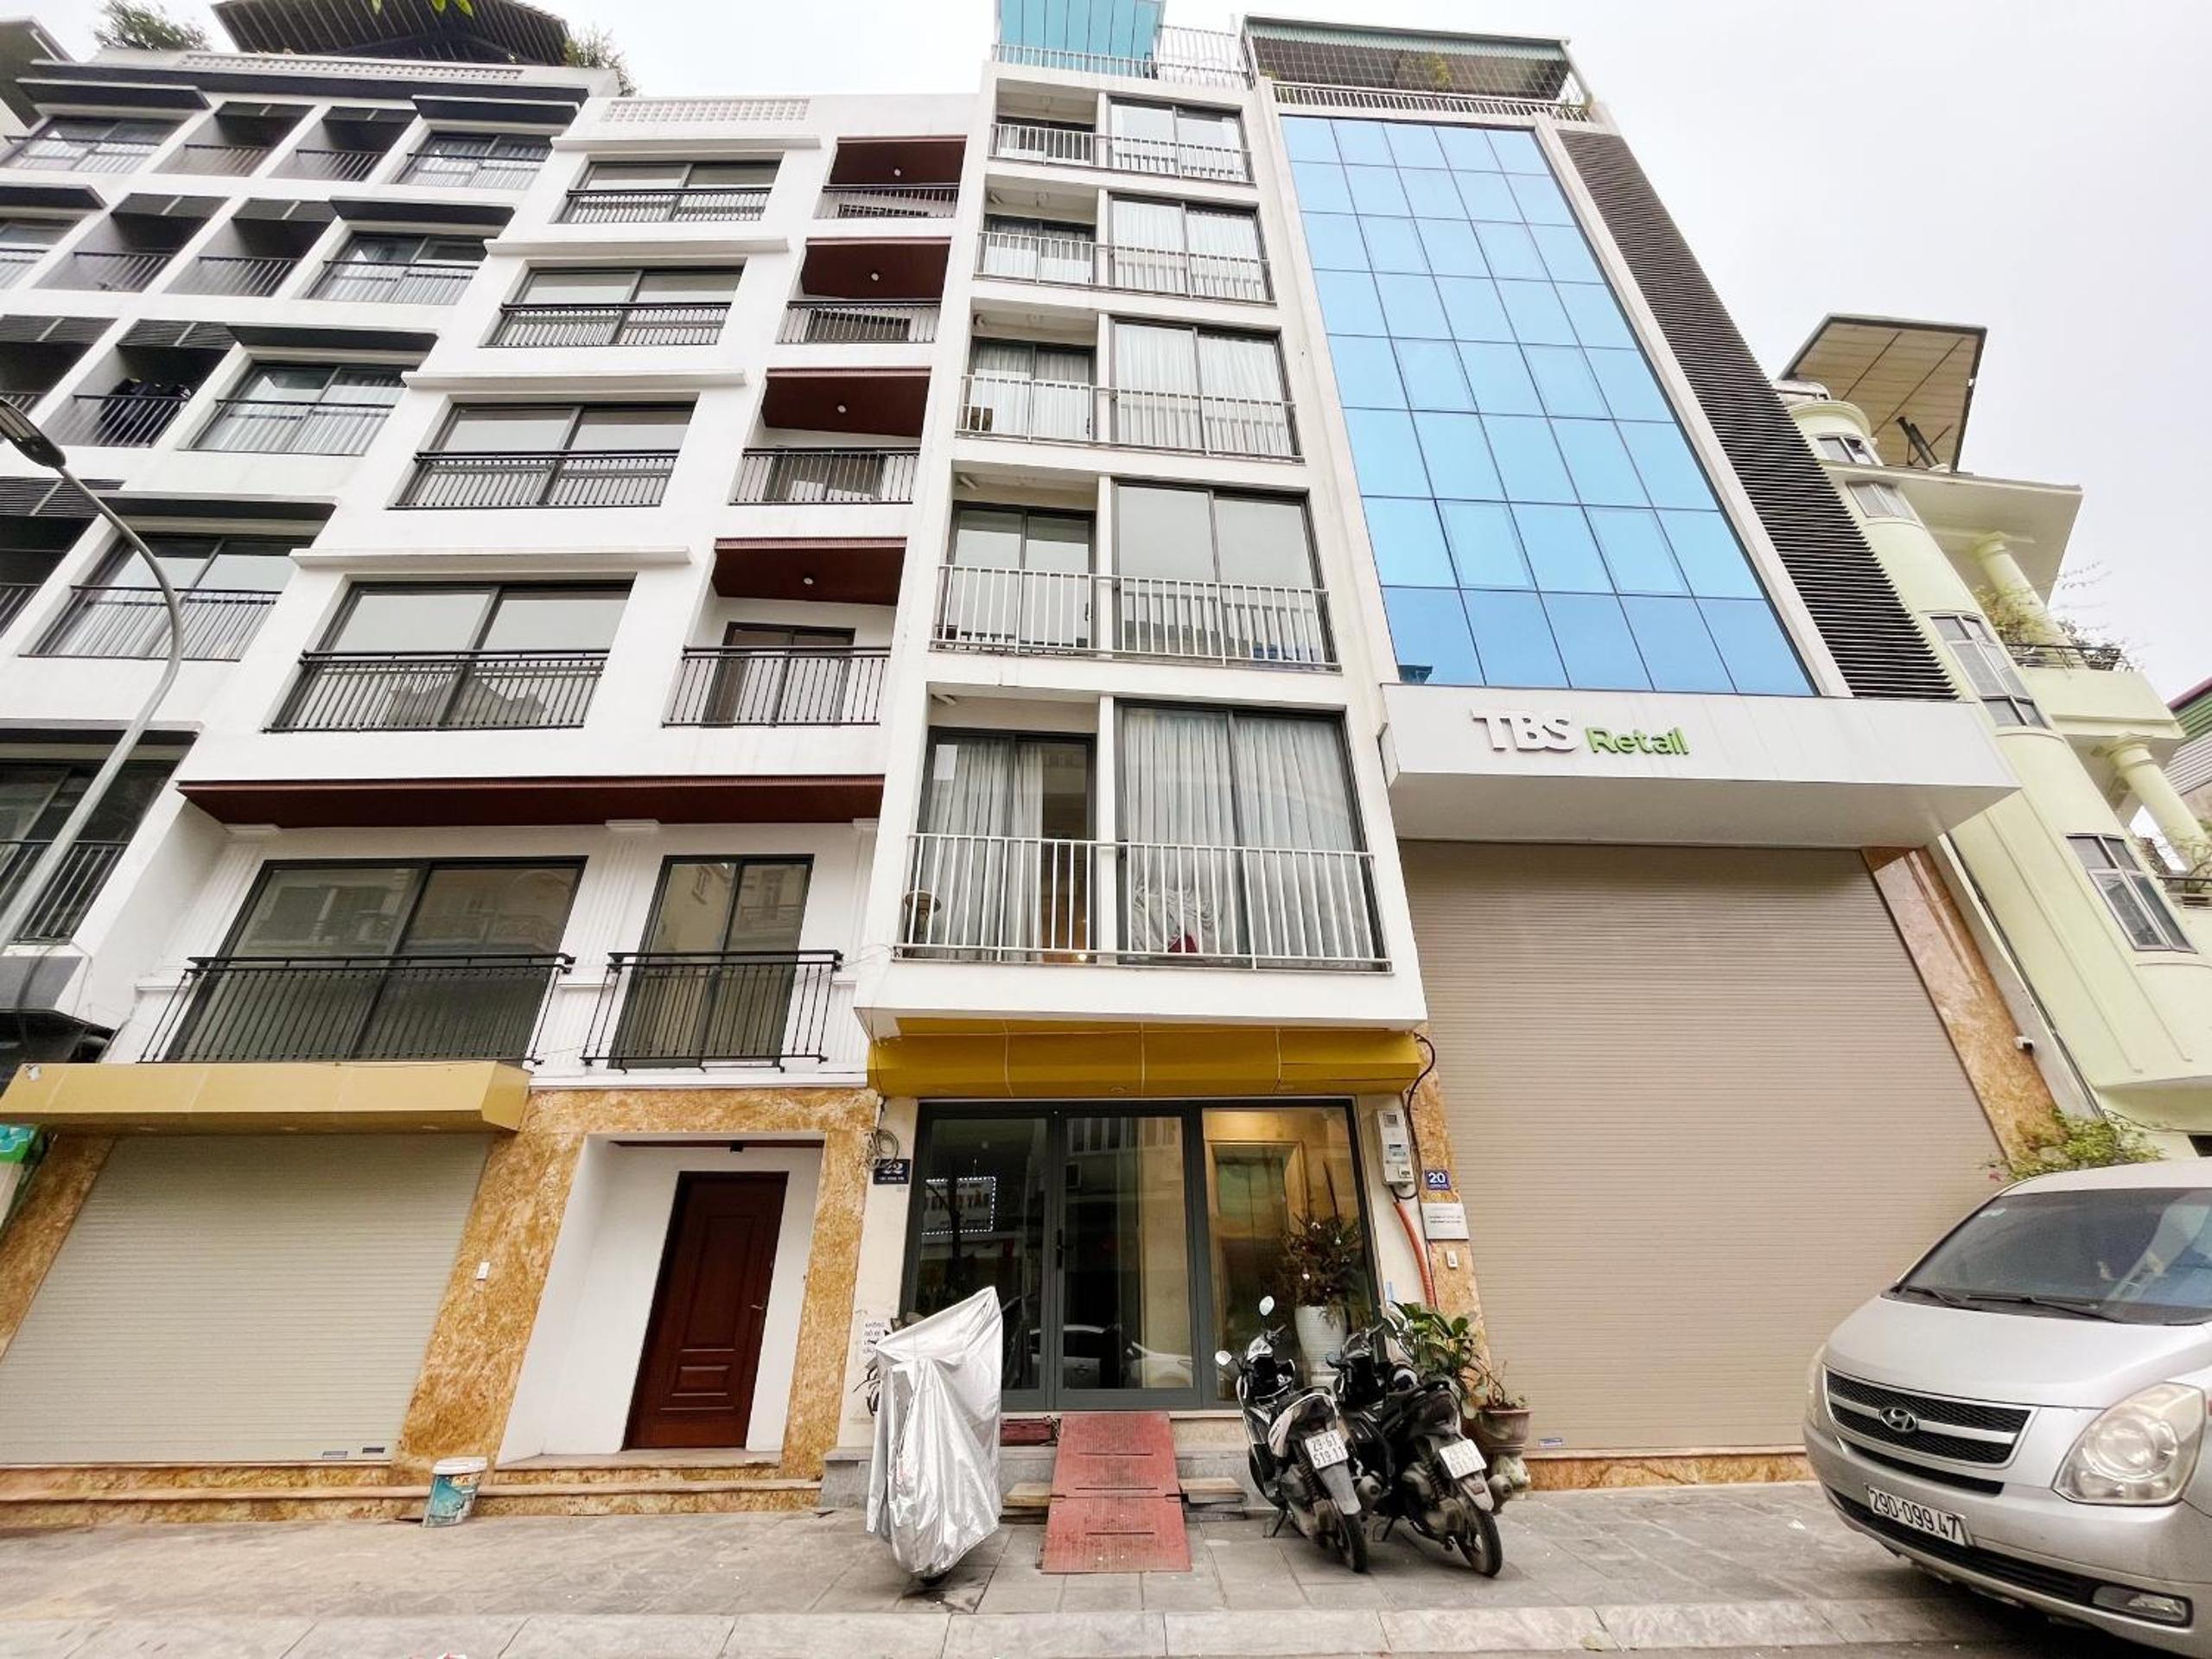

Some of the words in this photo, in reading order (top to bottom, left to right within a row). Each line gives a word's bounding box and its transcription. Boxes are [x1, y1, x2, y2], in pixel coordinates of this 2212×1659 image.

[1470, 708, 1577, 753] TBS
[1585, 726, 1689, 755] Retail
[1428, 1172, 1446, 1184] 20
[1869, 1489, 1960, 1540] 29D-099.47
